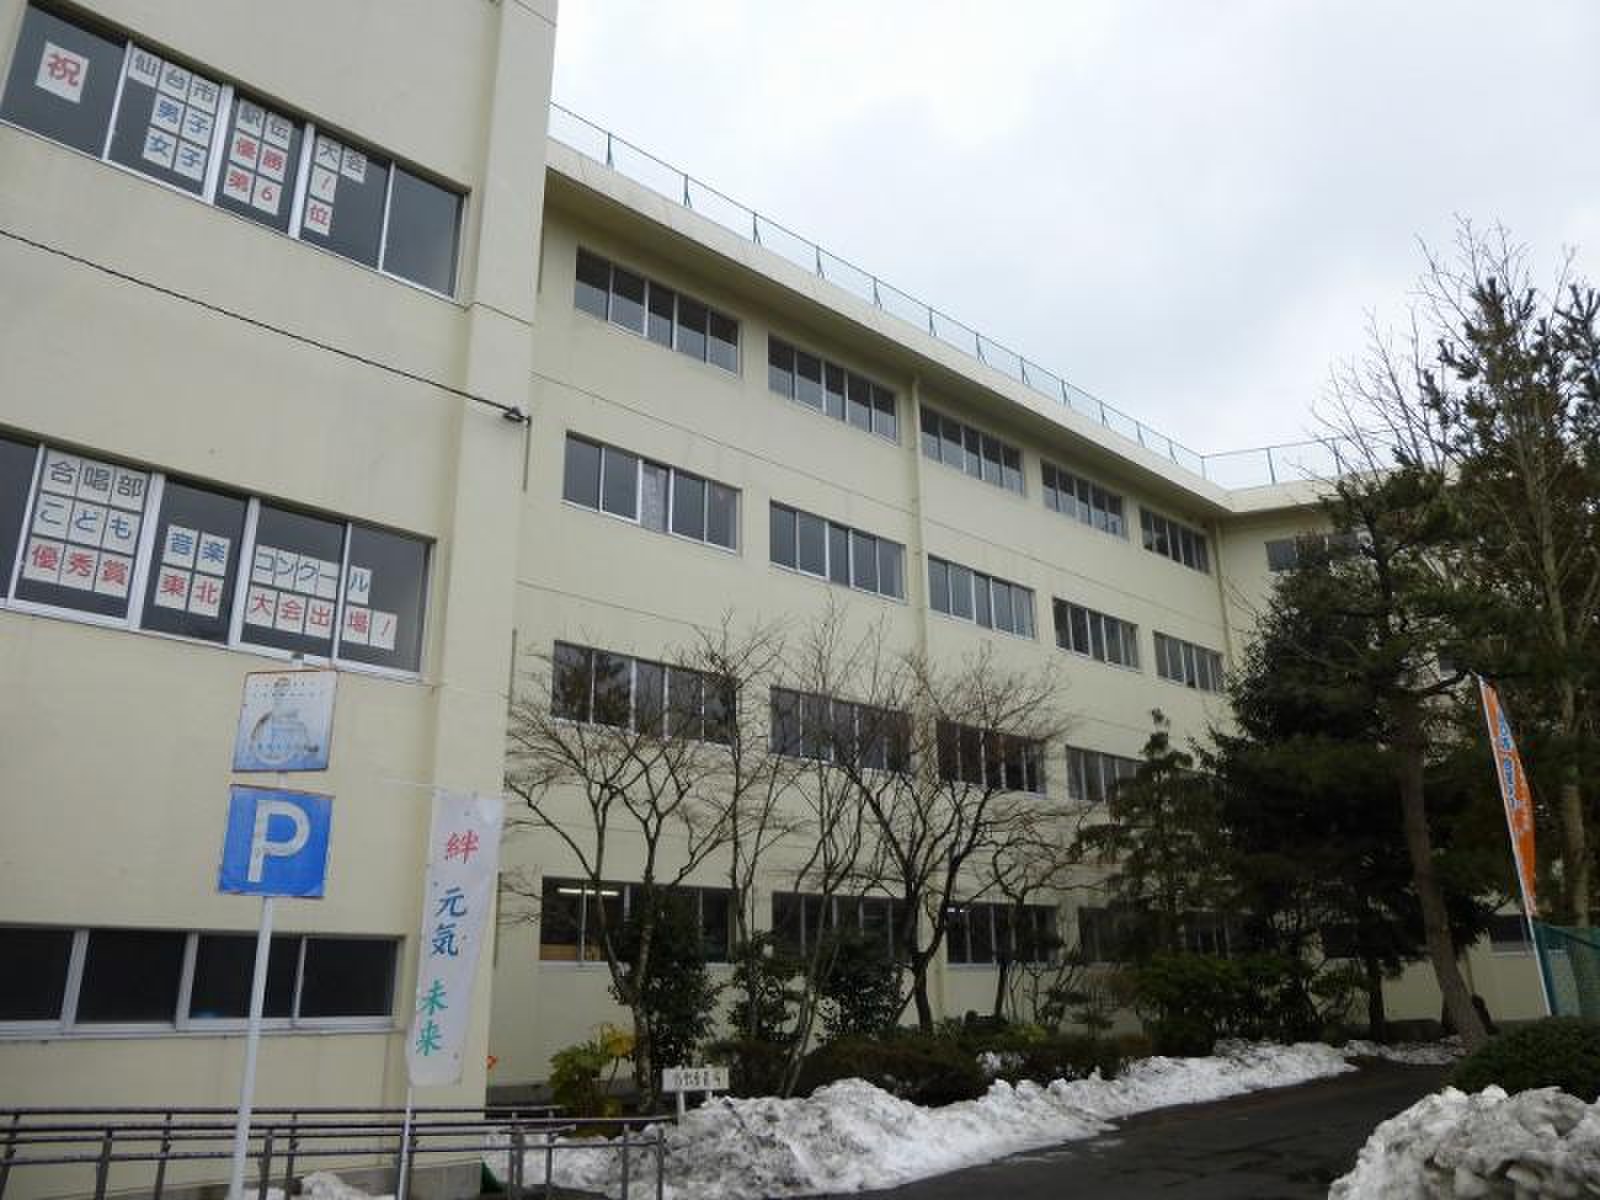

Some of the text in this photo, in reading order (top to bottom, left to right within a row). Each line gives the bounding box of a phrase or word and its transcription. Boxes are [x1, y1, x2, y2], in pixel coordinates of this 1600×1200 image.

[46, 50, 81, 88] 祝
[50, 460, 144, 499] 合唱部
[39, 501, 131, 540] こども
[32, 543, 130, 586] 優秀賞
[247, 799, 311, 883] P
[445, 829, 479, 865] 絆
[431, 886, 468, 957] 元気
[415, 979, 449, 1058] 未来
